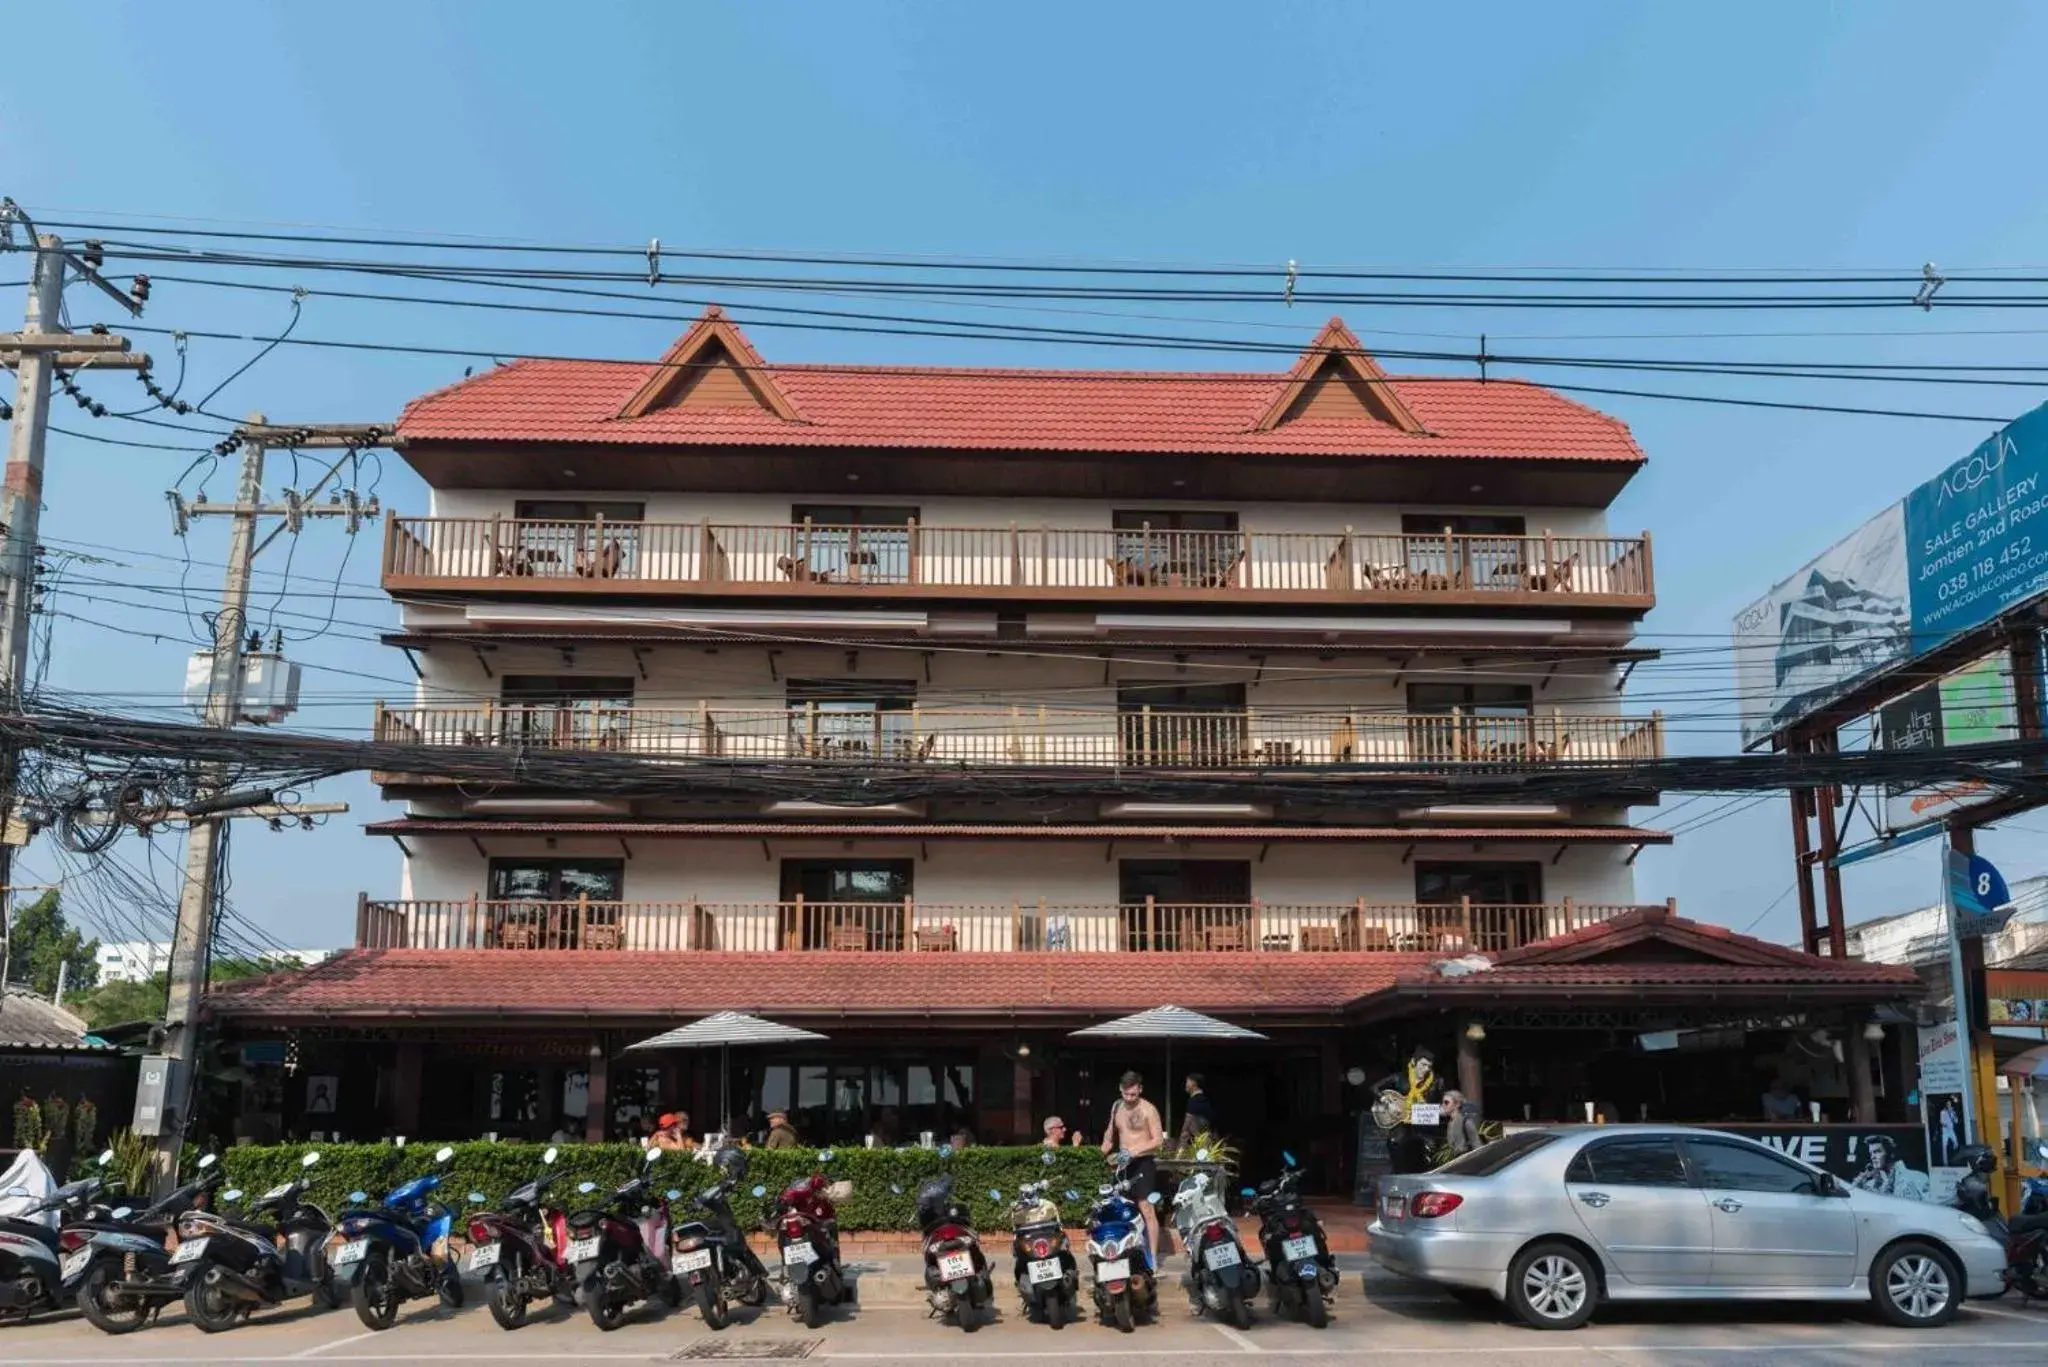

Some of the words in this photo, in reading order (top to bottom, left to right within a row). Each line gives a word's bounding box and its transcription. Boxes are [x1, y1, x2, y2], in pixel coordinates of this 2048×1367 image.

[1937, 435, 2018, 507] ACQUA
[1925, 521, 1962, 555] SALE
[1966, 472, 2039, 530] GALLERY
[1918, 538, 1974, 581] Jomtien
[1978, 518, 2005, 547] 2nd
[1938, 572, 1968, 600] 038
[1972, 557, 1995, 582] 118
[1999, 536, 2031, 565] 452
[1978, 872, 1990, 896] 8
